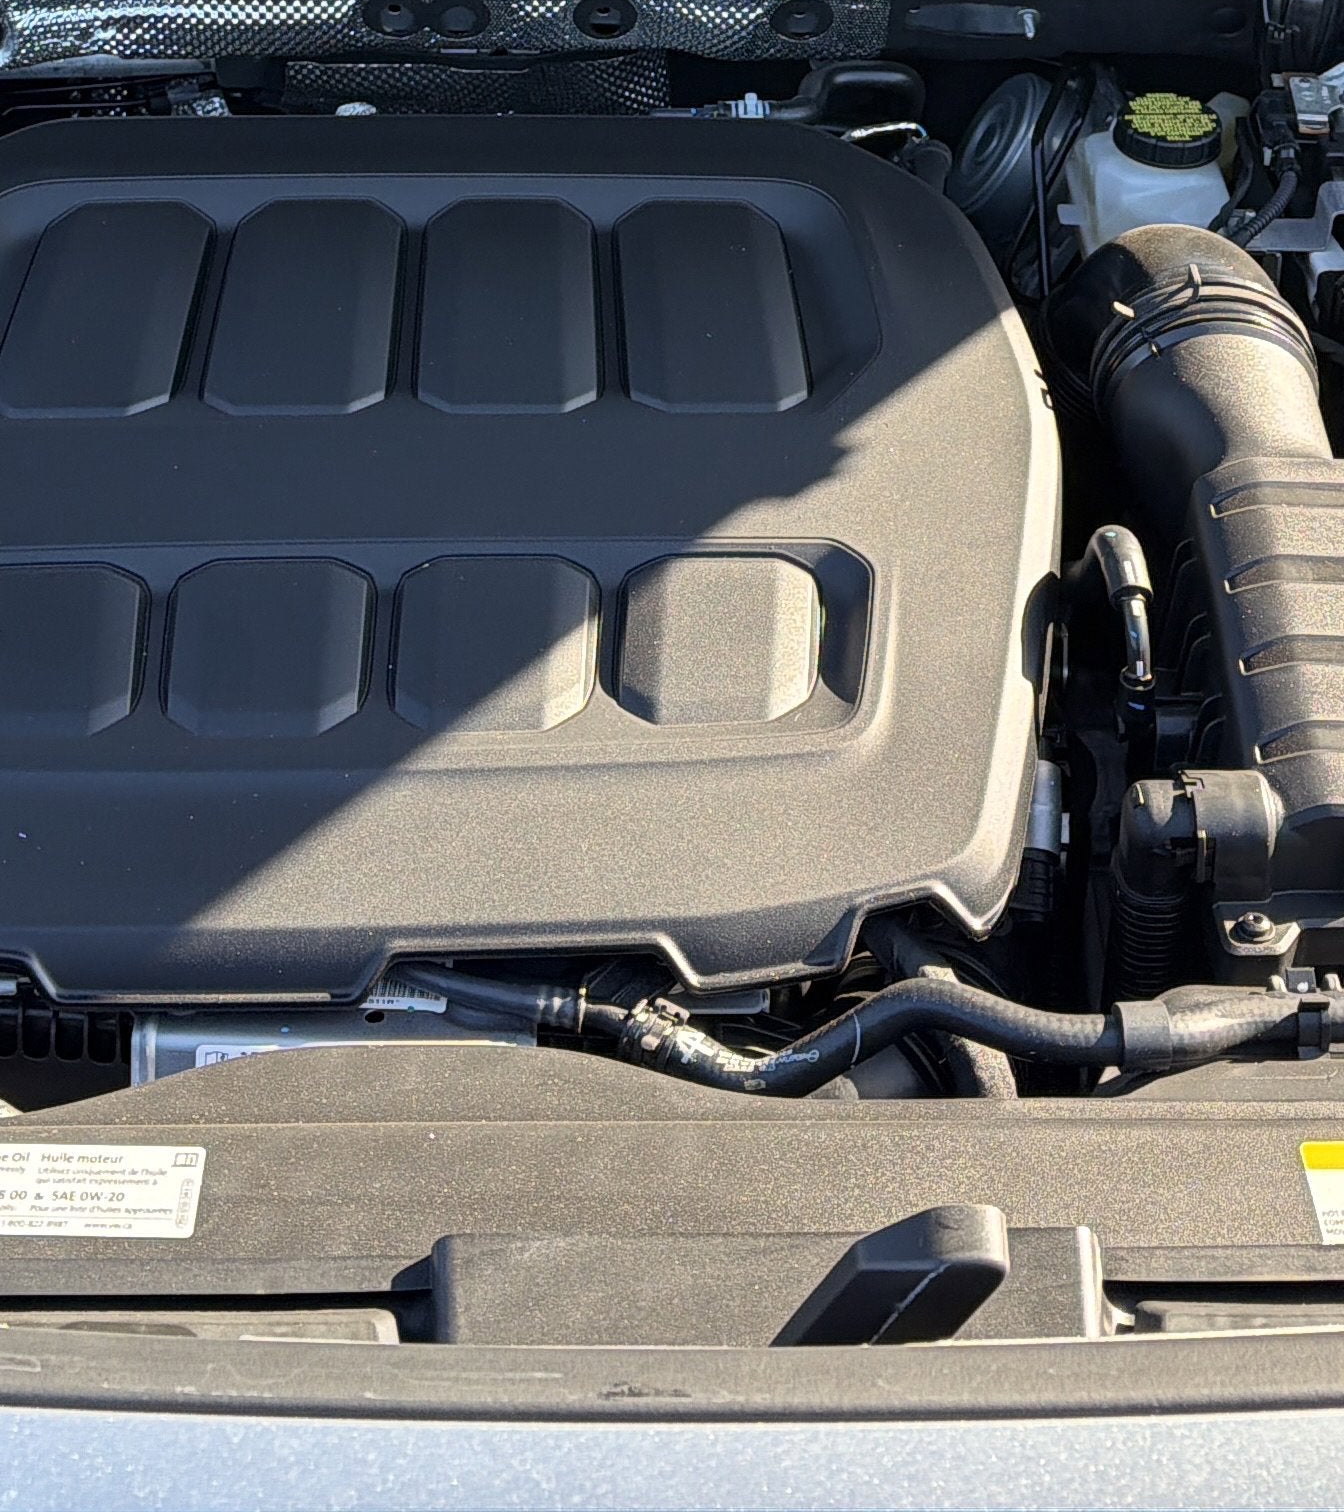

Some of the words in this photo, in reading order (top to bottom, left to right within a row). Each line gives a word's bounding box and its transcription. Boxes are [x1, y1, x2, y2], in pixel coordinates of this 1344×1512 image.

[11, 1151, 32, 1162] Oil
[40, 1152, 75, 1164] Huile
[77, 1155, 124, 1164] moteur
[8, 1190, 28, 1201] 00
[33, 1192, 45, 1201] &
[52, 1190, 76, 1202] SAE
